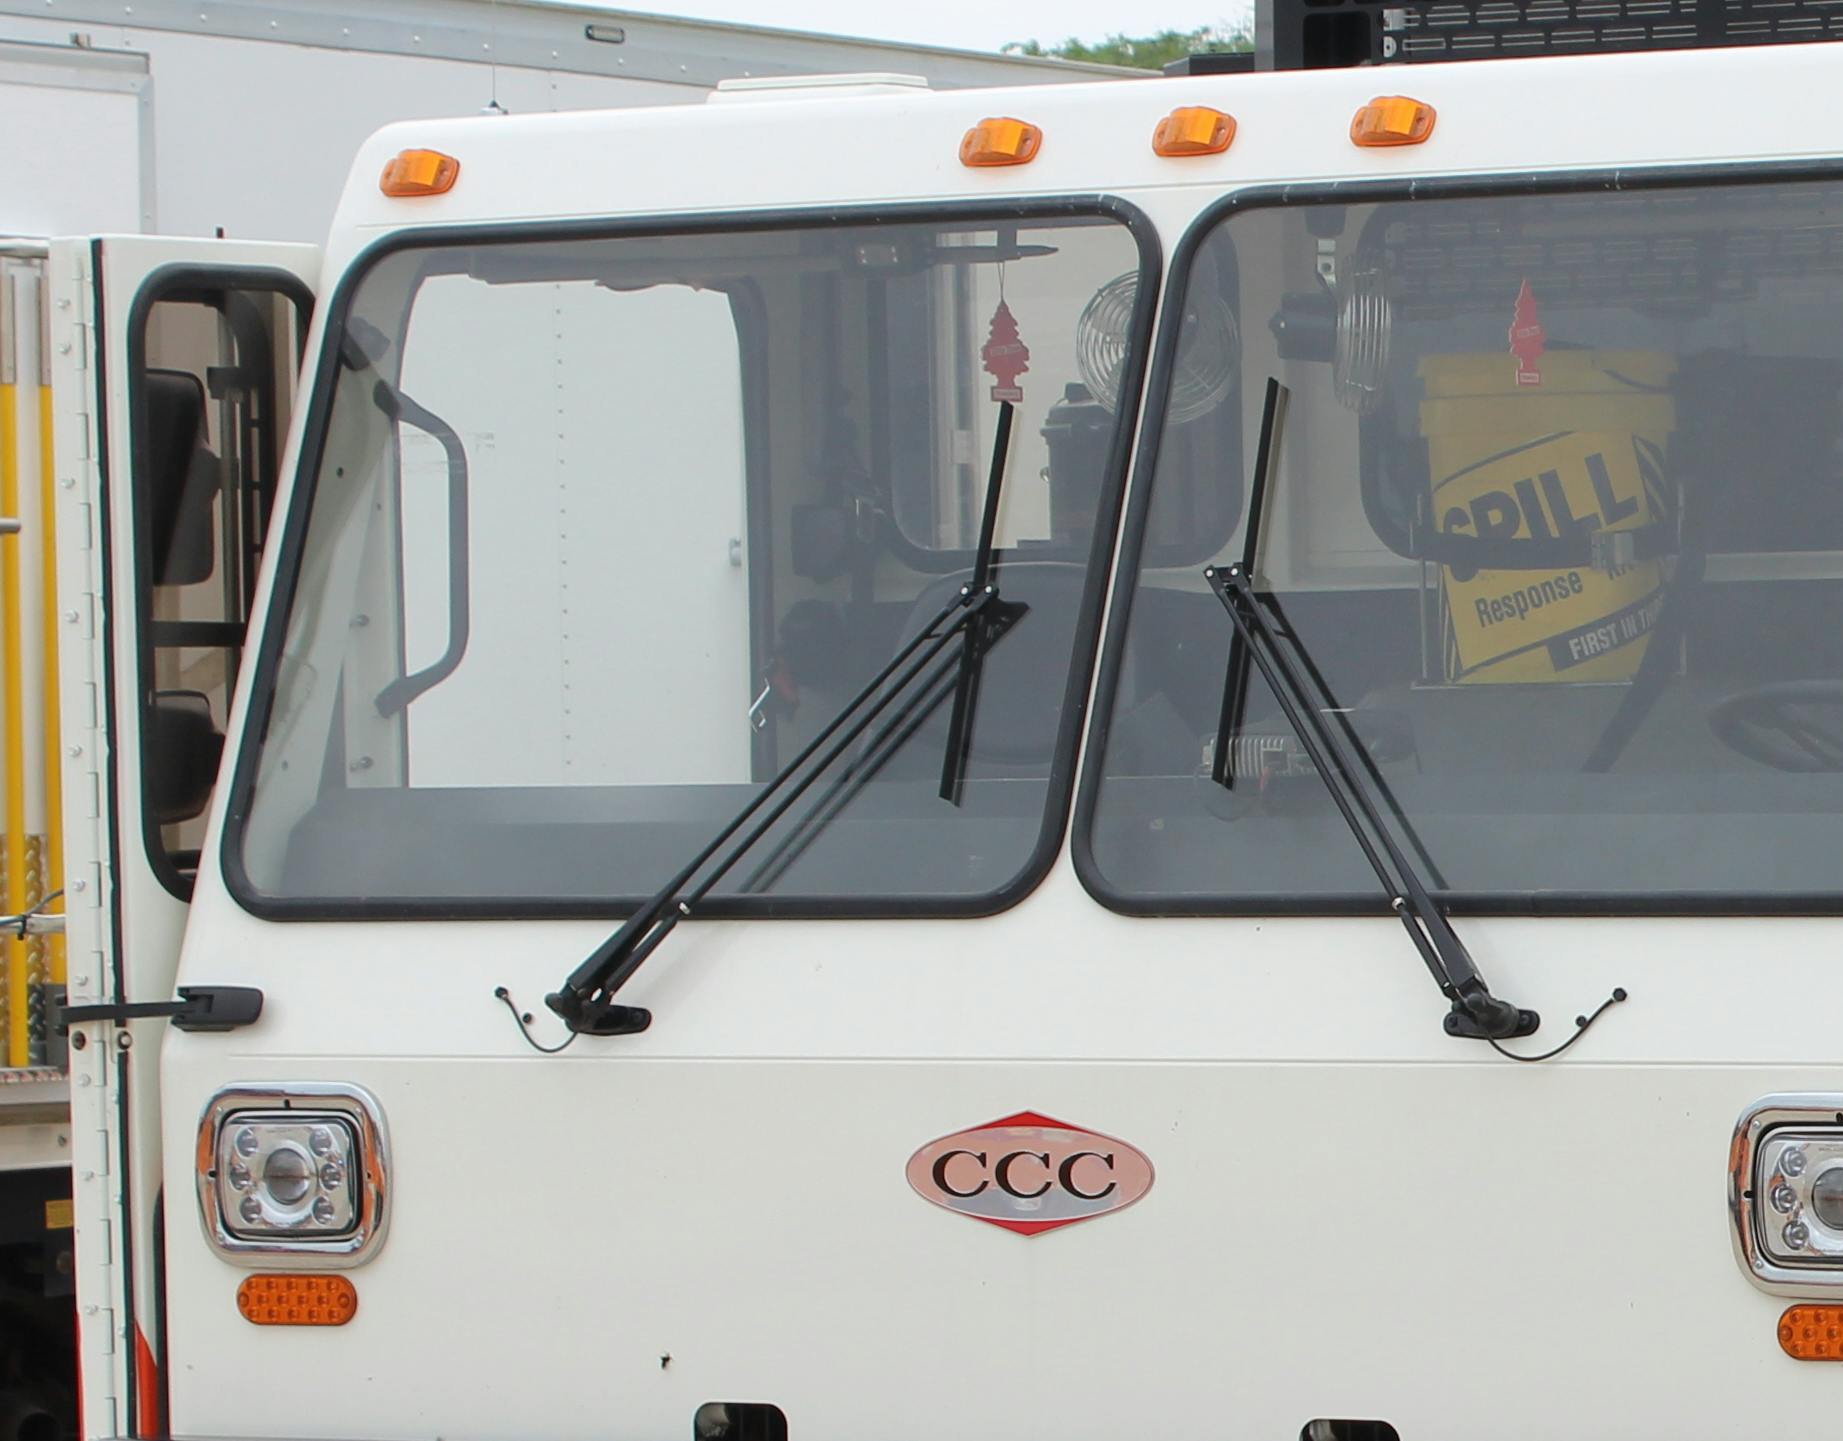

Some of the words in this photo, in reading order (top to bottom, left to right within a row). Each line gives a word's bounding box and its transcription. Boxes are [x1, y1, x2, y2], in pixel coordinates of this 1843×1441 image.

[1443, 452, 1640, 582] SPILL
[1474, 571, 1584, 628] Response
[1569, 622, 1619, 660] FIRST
[1620, 616, 1638, 640] IN
[932, 1150, 1117, 1200] CCC
